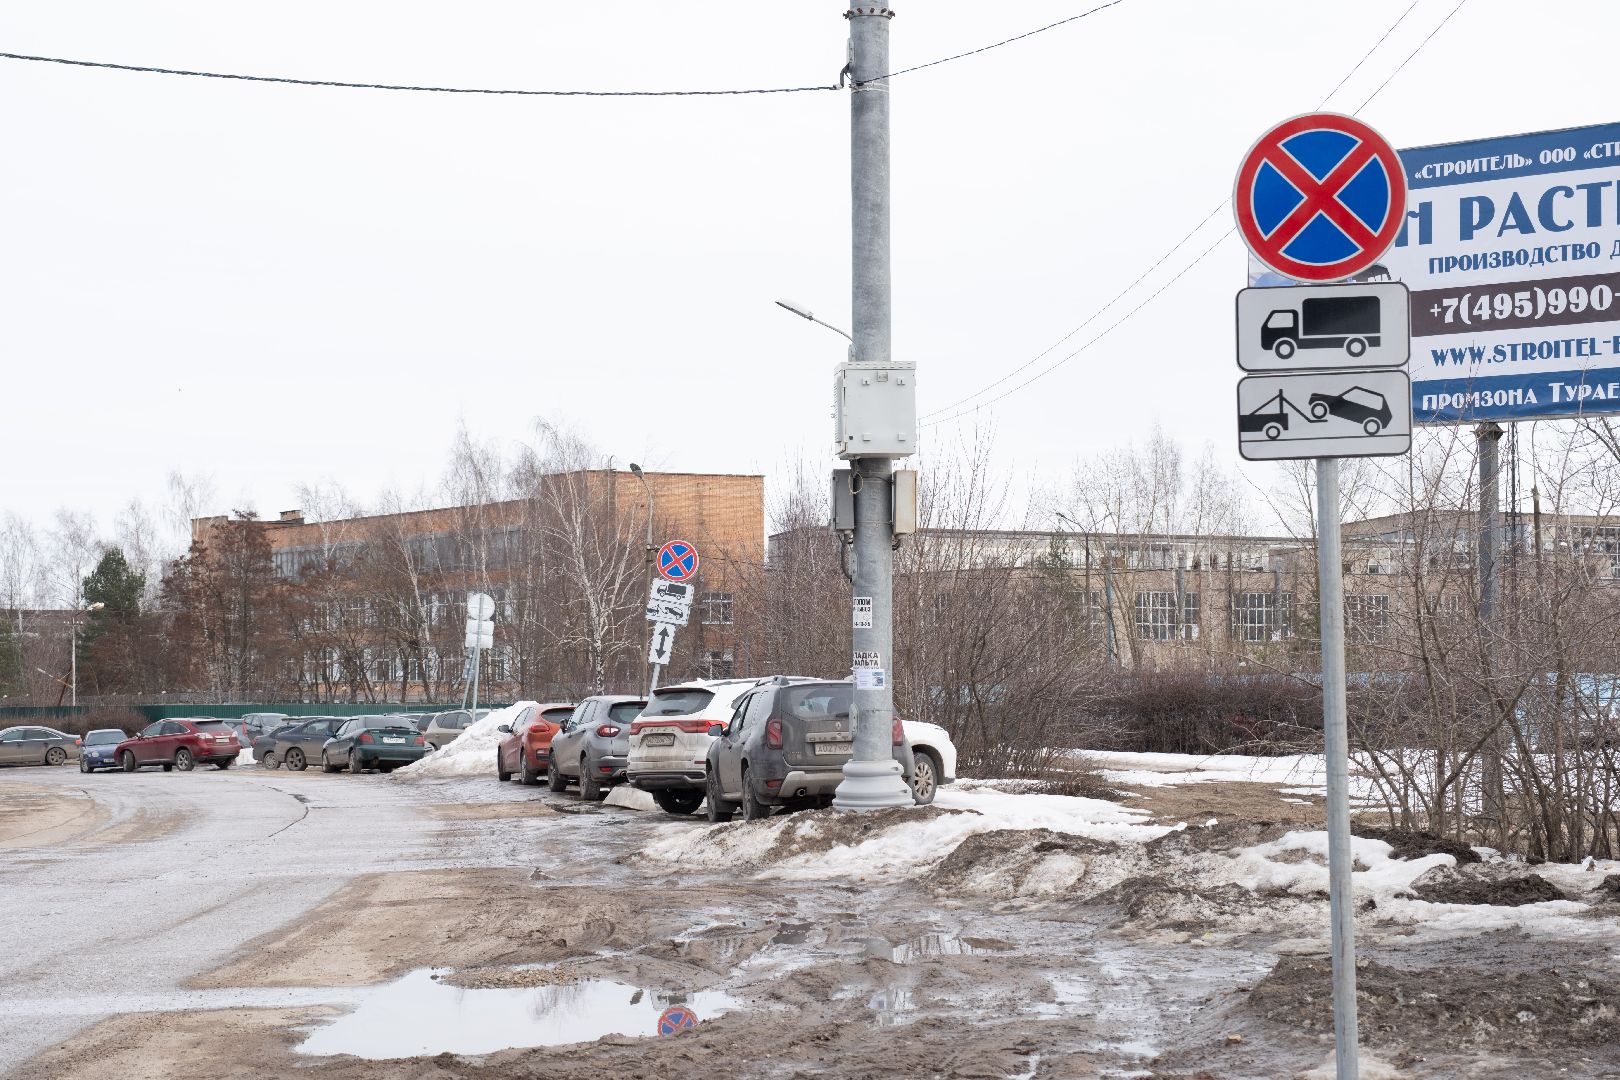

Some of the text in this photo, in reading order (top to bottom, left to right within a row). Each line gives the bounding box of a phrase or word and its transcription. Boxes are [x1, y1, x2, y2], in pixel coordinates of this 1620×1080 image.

[1414, 153, 1533, 179] «СТРОИТЕЛЬ»
[1539, 146, 1577, 165] ООО
[1460, 179, 1620, 242] РАСТ
[1428, 241, 1601, 275] ПРОИЗВОДСТВО
